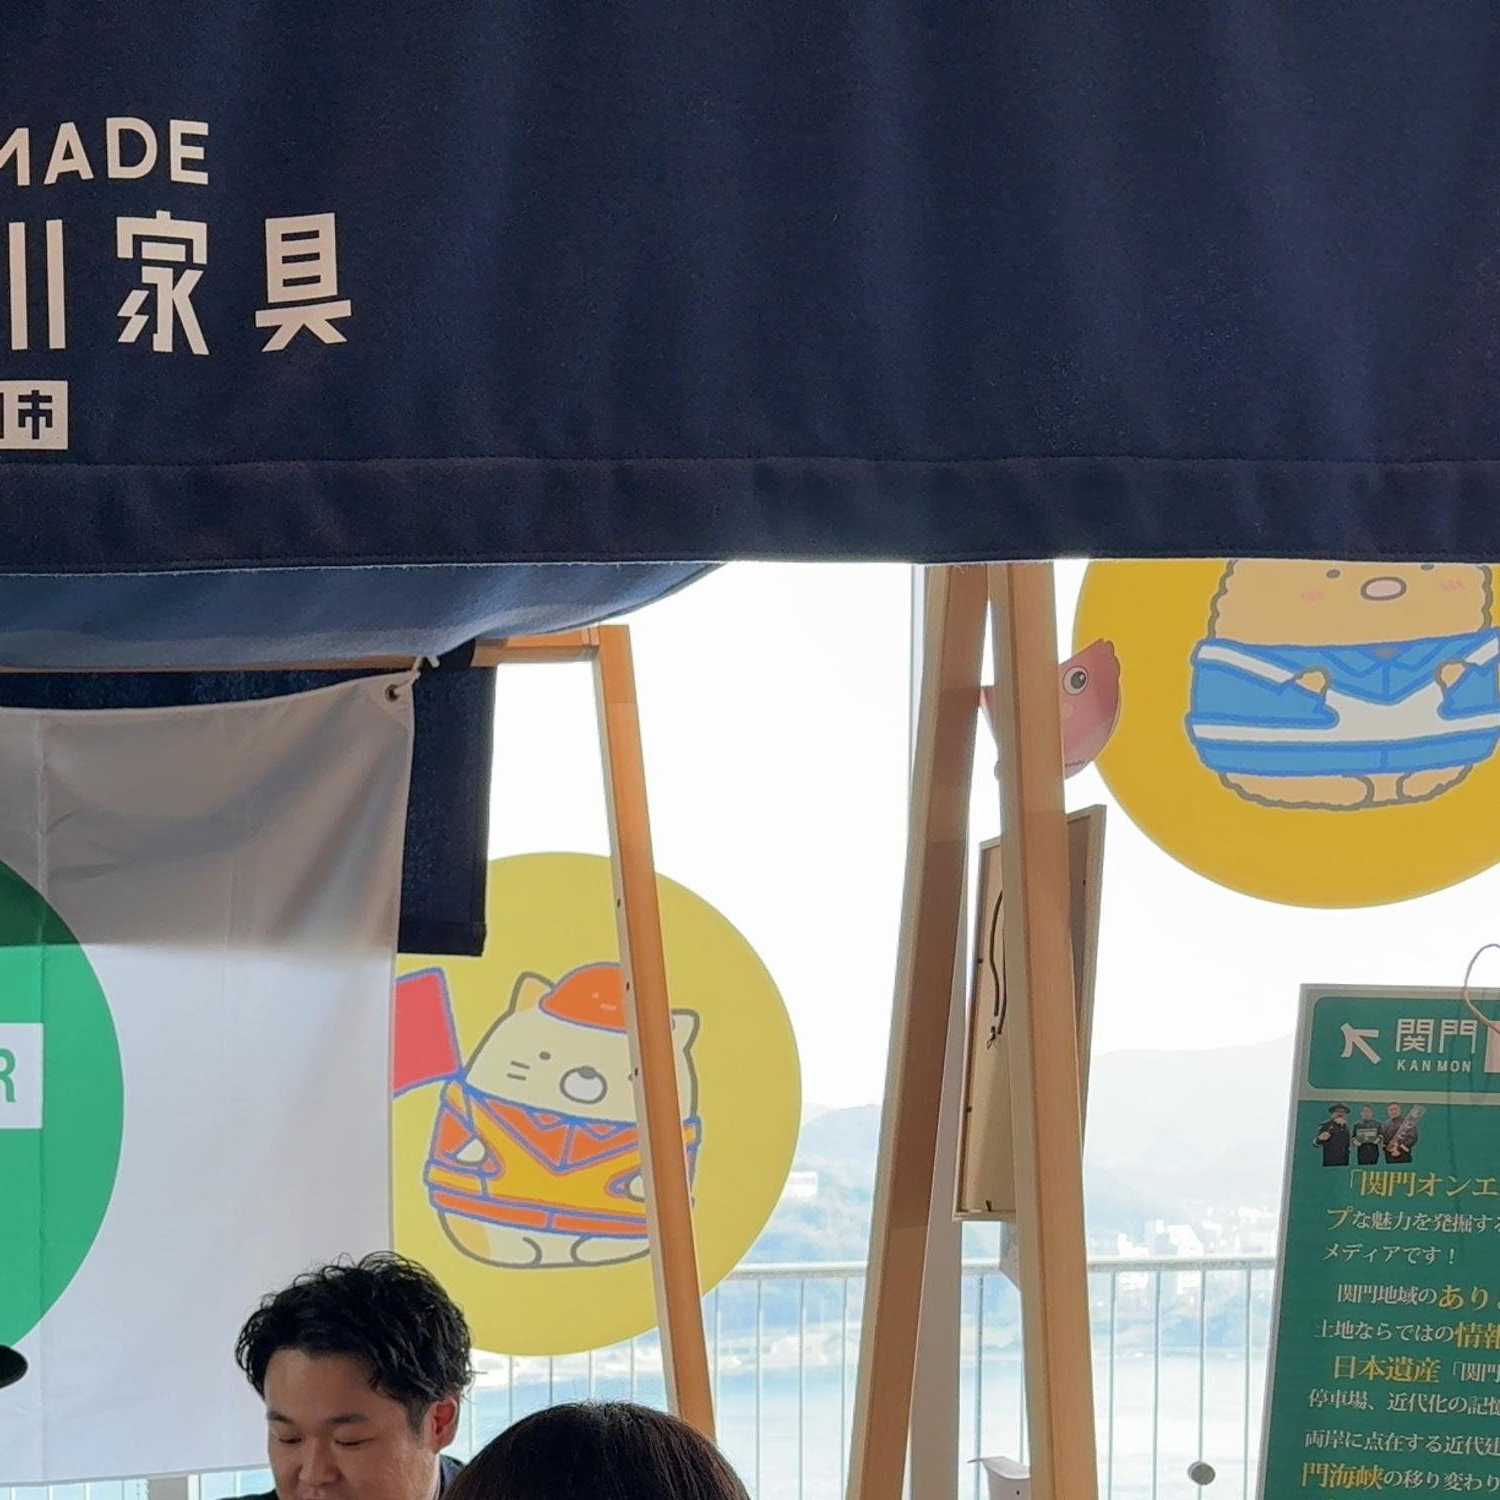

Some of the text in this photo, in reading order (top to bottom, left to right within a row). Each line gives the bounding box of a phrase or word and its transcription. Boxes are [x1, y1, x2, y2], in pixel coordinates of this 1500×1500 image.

[1395, 1018, 1478, 1055] 関門
[1337, 1283, 1500, 1311] 関門地域のあり
